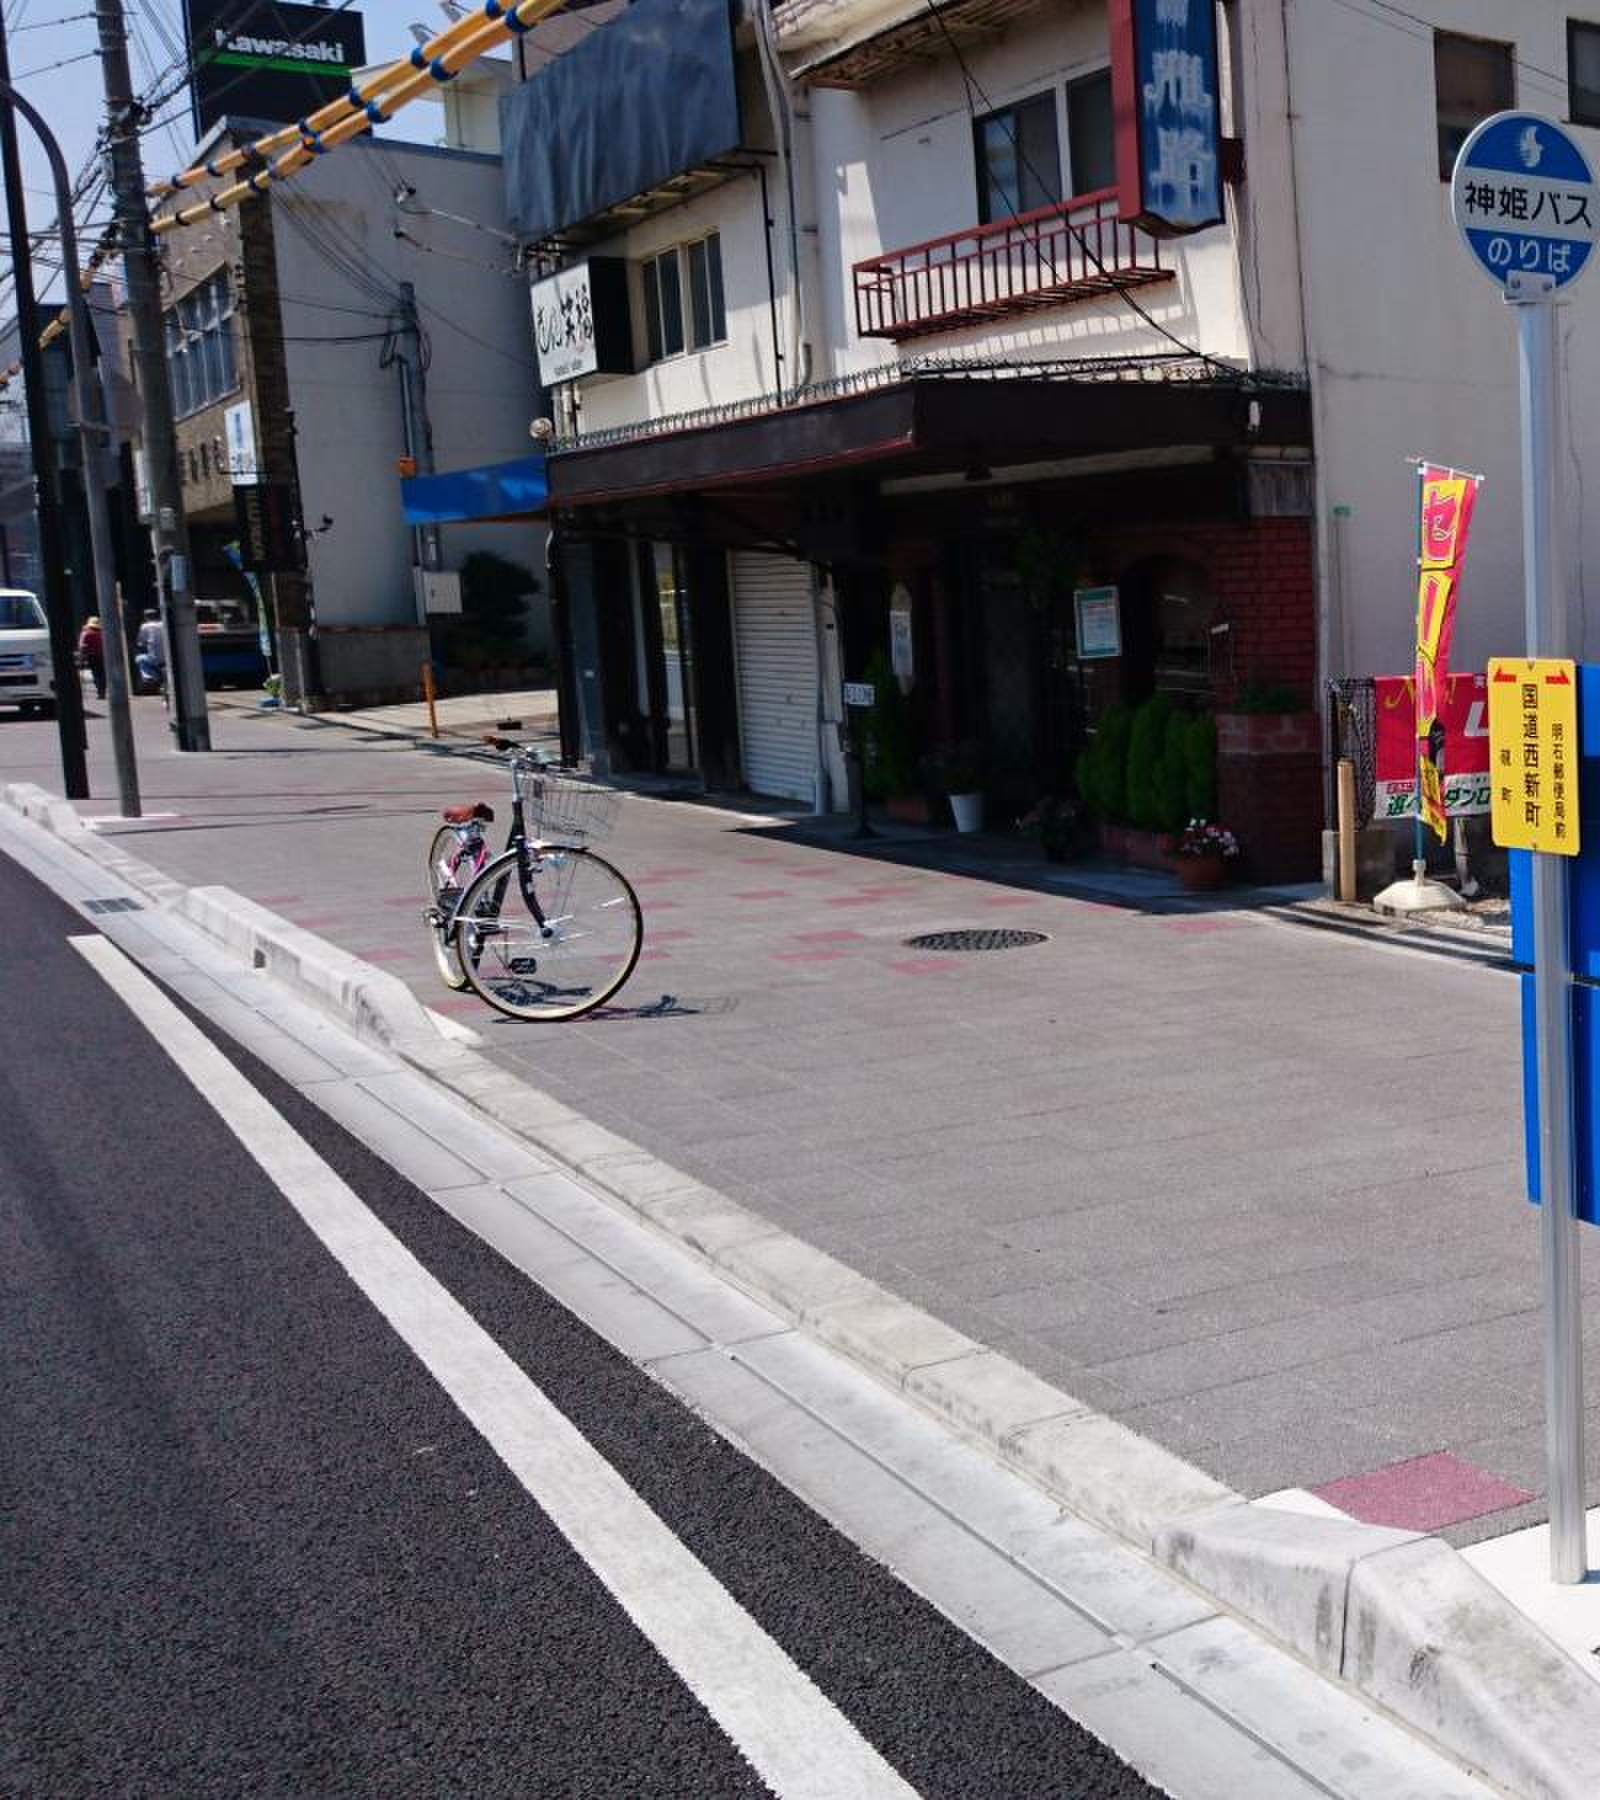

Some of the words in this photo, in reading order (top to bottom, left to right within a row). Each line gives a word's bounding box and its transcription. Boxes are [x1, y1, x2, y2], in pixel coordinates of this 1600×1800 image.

[214, 28, 345, 63] Kawasaki
[1463, 181, 1593, 229] 神姫バス
[1487, 237, 1572, 273] のりば
[1463, 702, 1489, 737] L
[1521, 683, 1540, 828] 国道西新町
[1444, 786, 1491, 808] ダンロ
